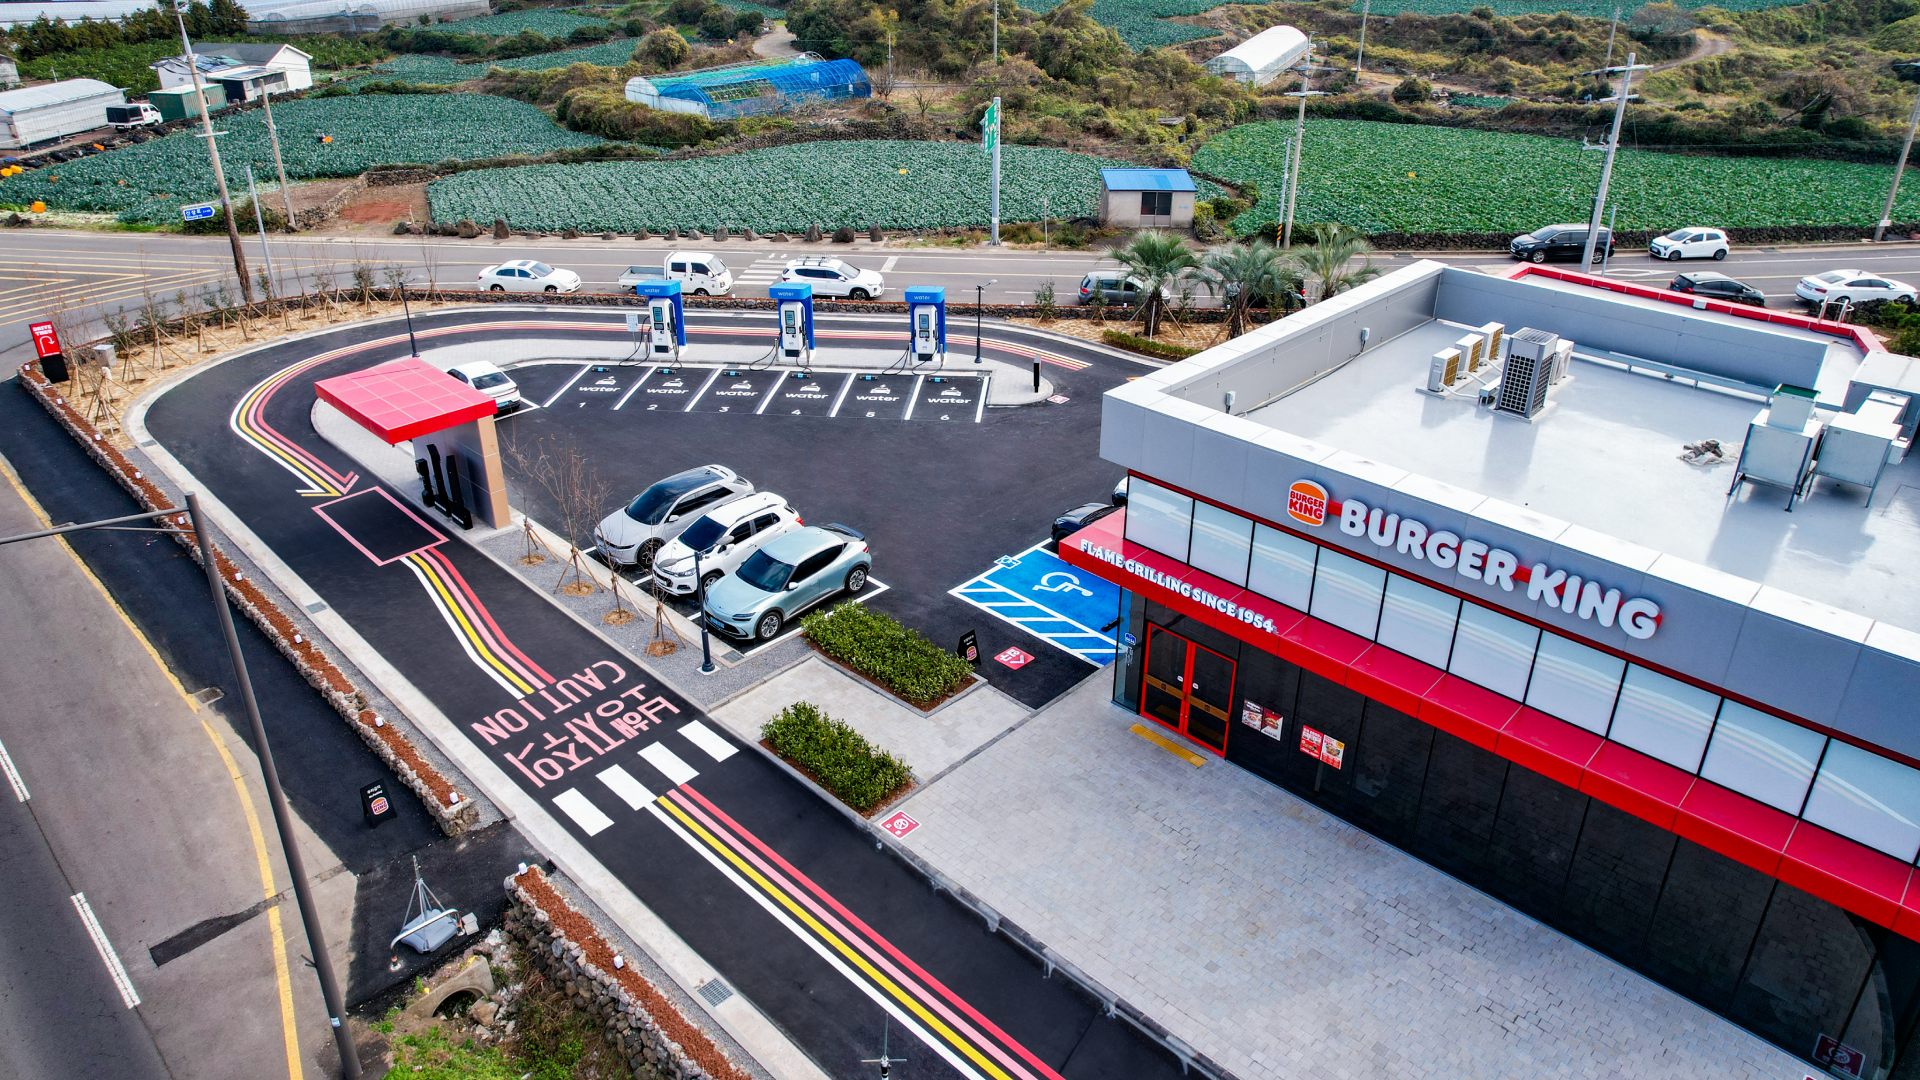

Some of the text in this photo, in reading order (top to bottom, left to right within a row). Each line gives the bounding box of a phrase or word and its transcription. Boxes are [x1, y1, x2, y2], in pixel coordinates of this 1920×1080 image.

[1289, 499, 1323, 519] KING
[1290, 491, 1324, 509] BURGER
[1080, 539, 1275, 634] FLAME GRILLING SINCE 1954
[1340, 498, 1661, 639] BURGER KING
[471, 660, 626, 746] CAUTION
[504, 684, 680, 788] 보행자주의
